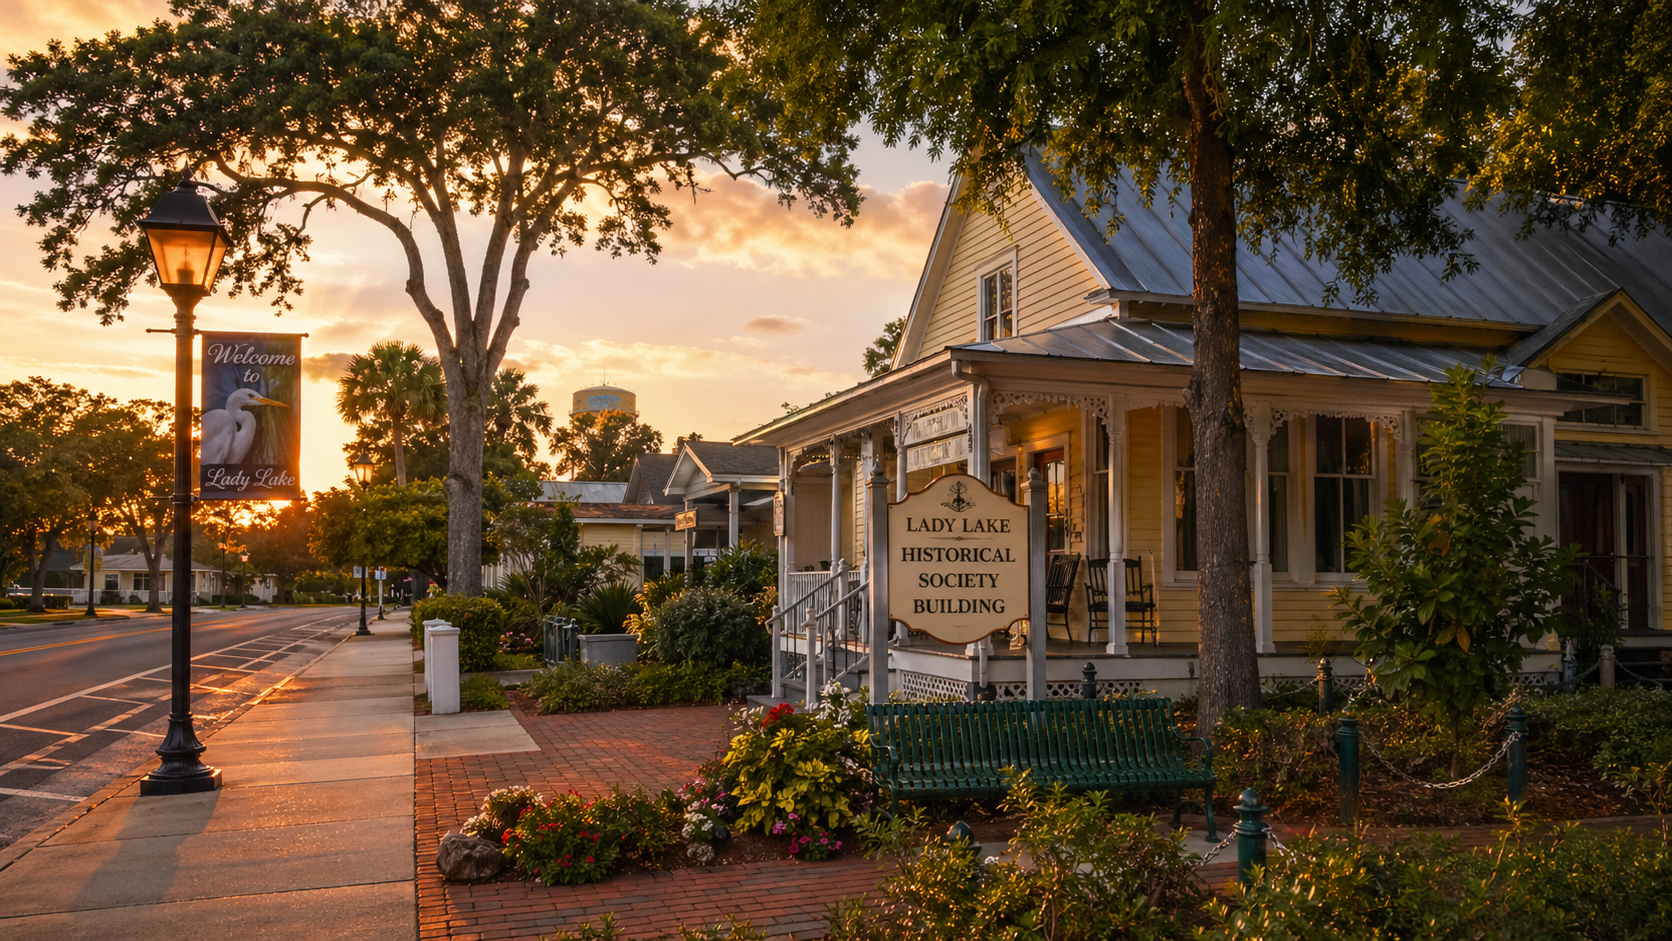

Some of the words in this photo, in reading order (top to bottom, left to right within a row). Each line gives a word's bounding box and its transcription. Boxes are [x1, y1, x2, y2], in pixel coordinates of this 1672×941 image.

[207, 343, 296, 366] Welcome
[243, 369, 260, 383] to
[205, 467, 251, 492] Lady
[253, 468, 296, 489] Lake
[906, 517, 957, 532] LADY
[962, 518, 1011, 533] LAKE
[901, 547, 1016, 563] HISTORICAL
[918, 573, 1000, 588] SOCIETY
[913, 598, 1005, 614] BUILDING
